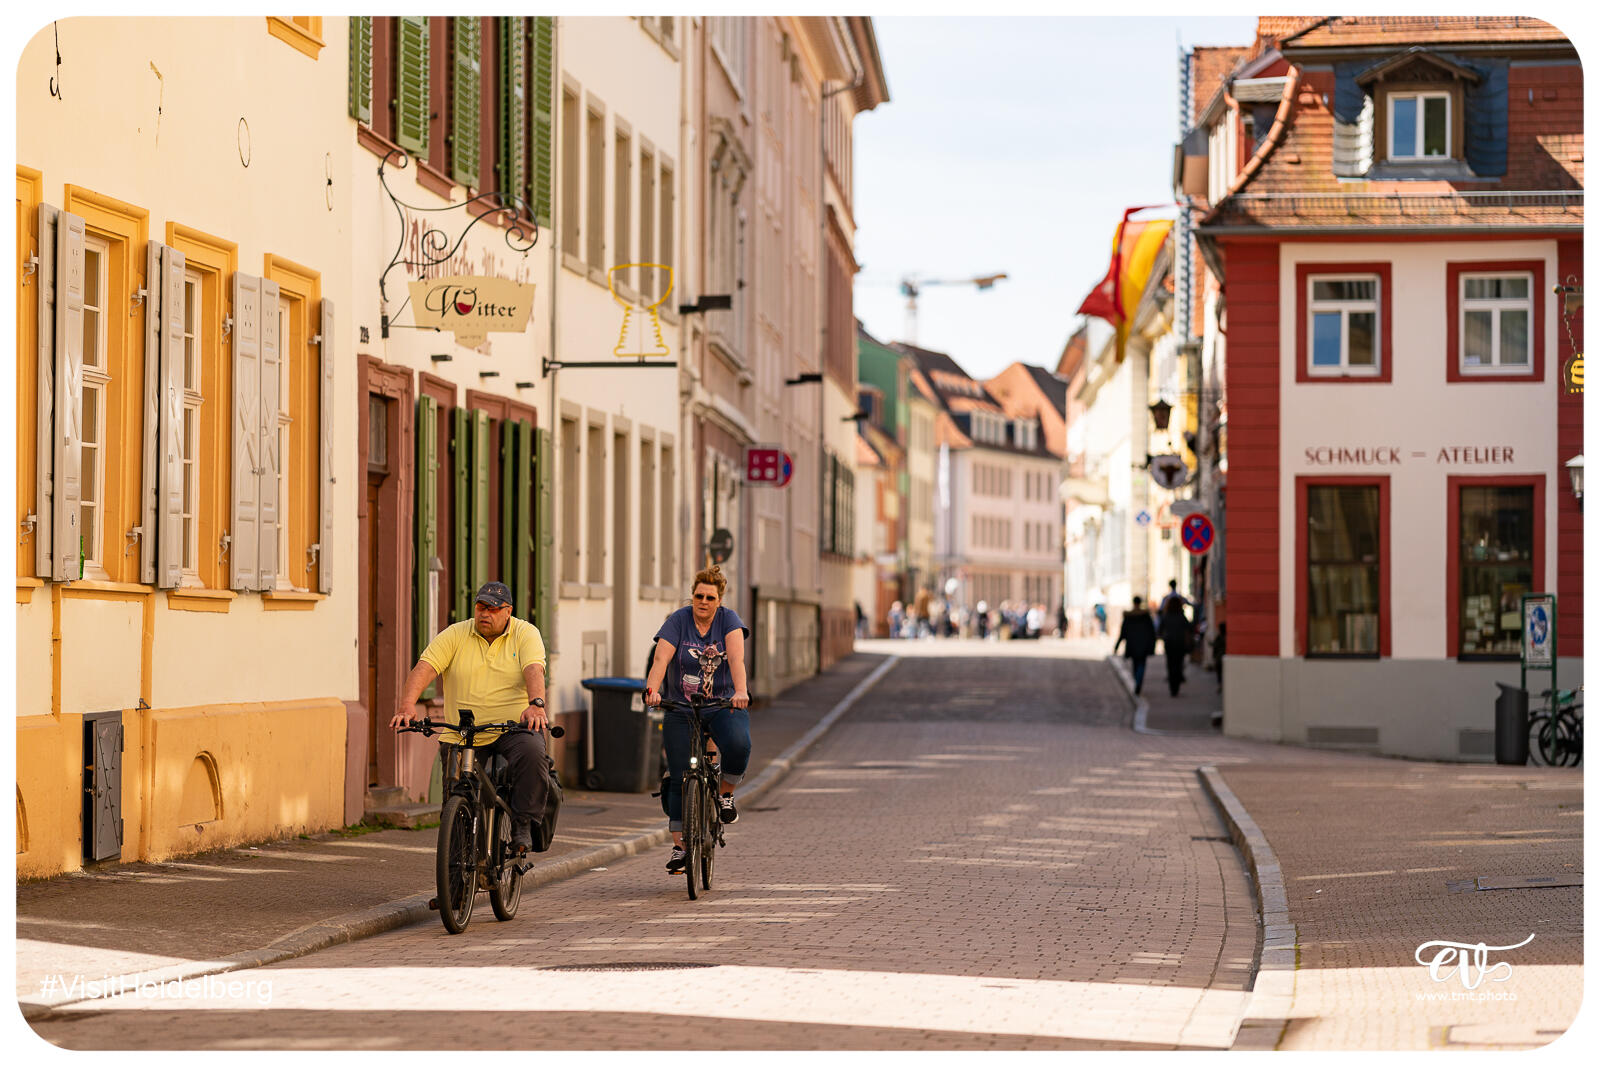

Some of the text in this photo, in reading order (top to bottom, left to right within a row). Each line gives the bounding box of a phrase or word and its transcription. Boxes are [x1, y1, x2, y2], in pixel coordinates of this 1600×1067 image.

[425, 285, 516, 318] Witter
[1304, 446, 1401, 466] SCHMUCK
[1437, 446, 1514, 465] ATELIER
